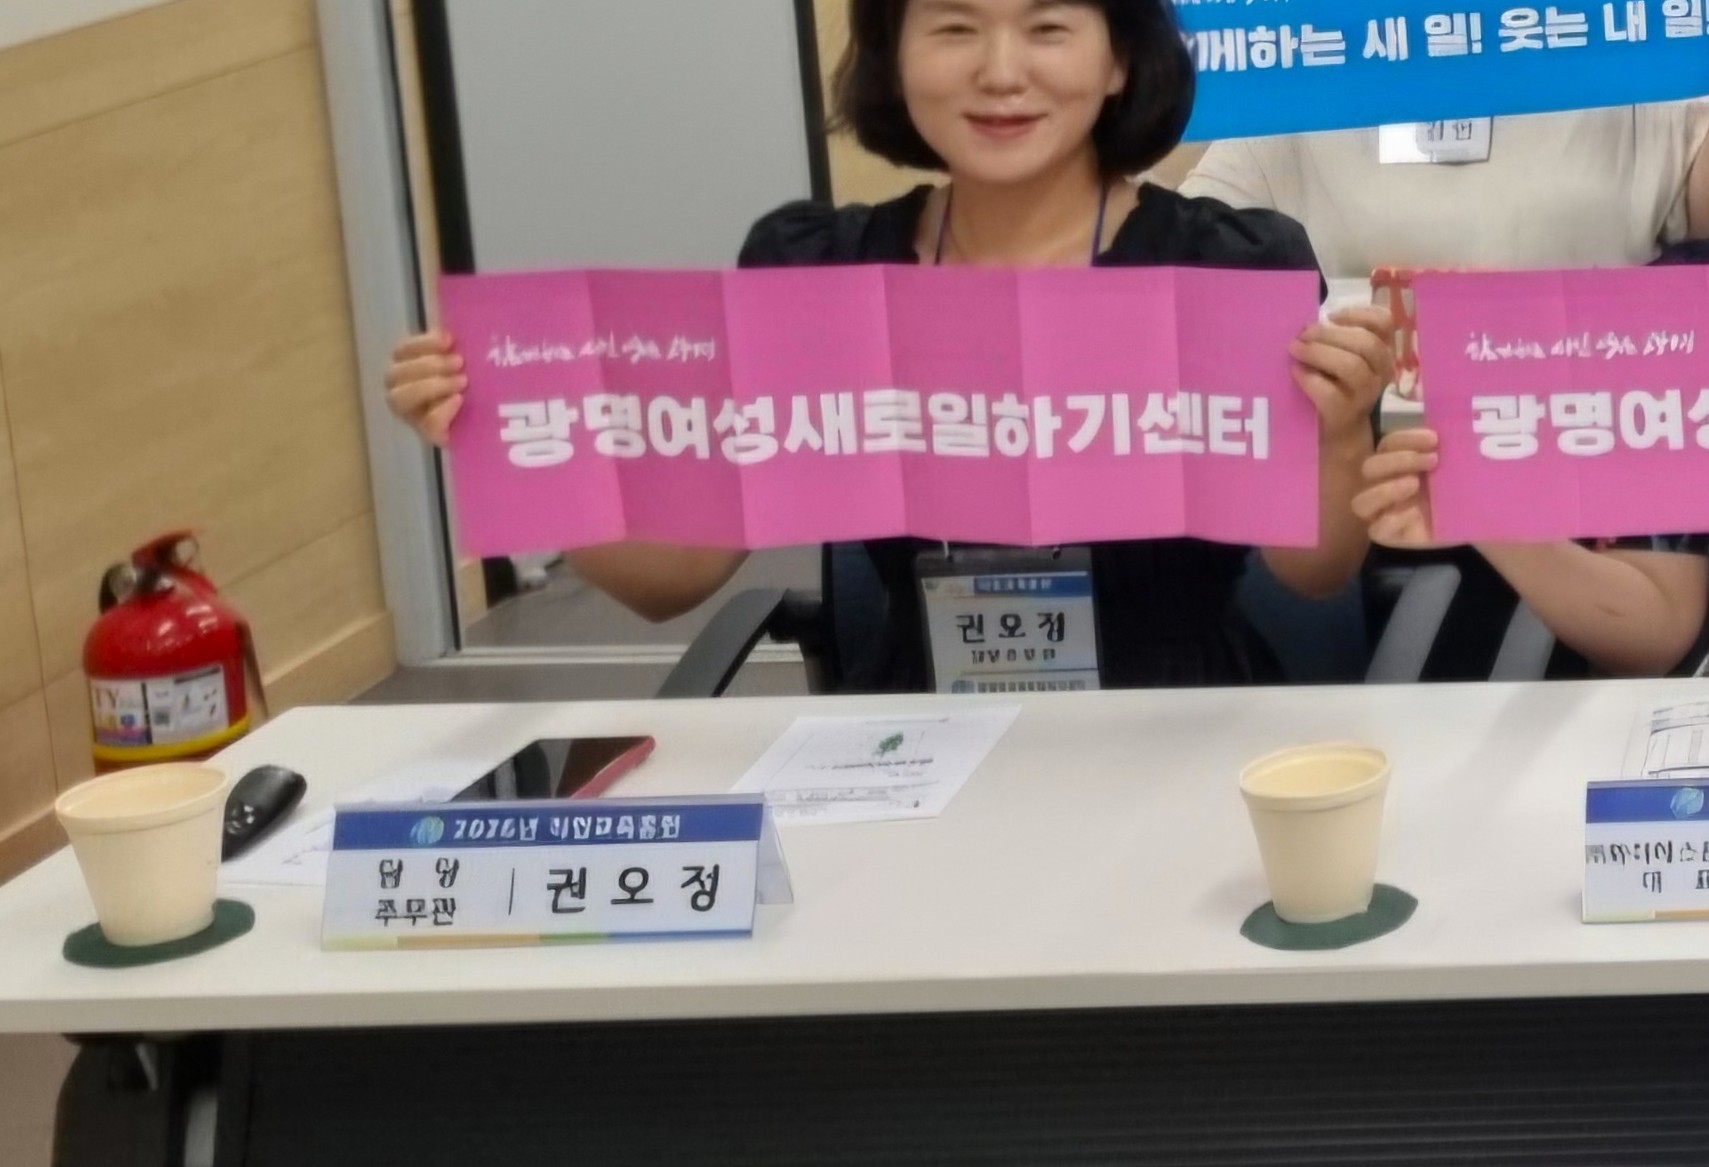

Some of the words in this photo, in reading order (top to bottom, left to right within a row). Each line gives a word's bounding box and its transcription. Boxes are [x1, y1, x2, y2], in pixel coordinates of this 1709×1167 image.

[1184, 25, 1345, 72] 께하는
[1363, 17, 1408, 60] 새
[1425, 13, 1481, 56] 일!
[1499, 7, 1588, 51] 웃는
[1603, 0, 1646, 41] 내
[499, 389, 1268, 467] 광명여성새로일하기센터
[954, 611, 1066, 644] 권오정
[546, 863, 720, 913] 권오정
